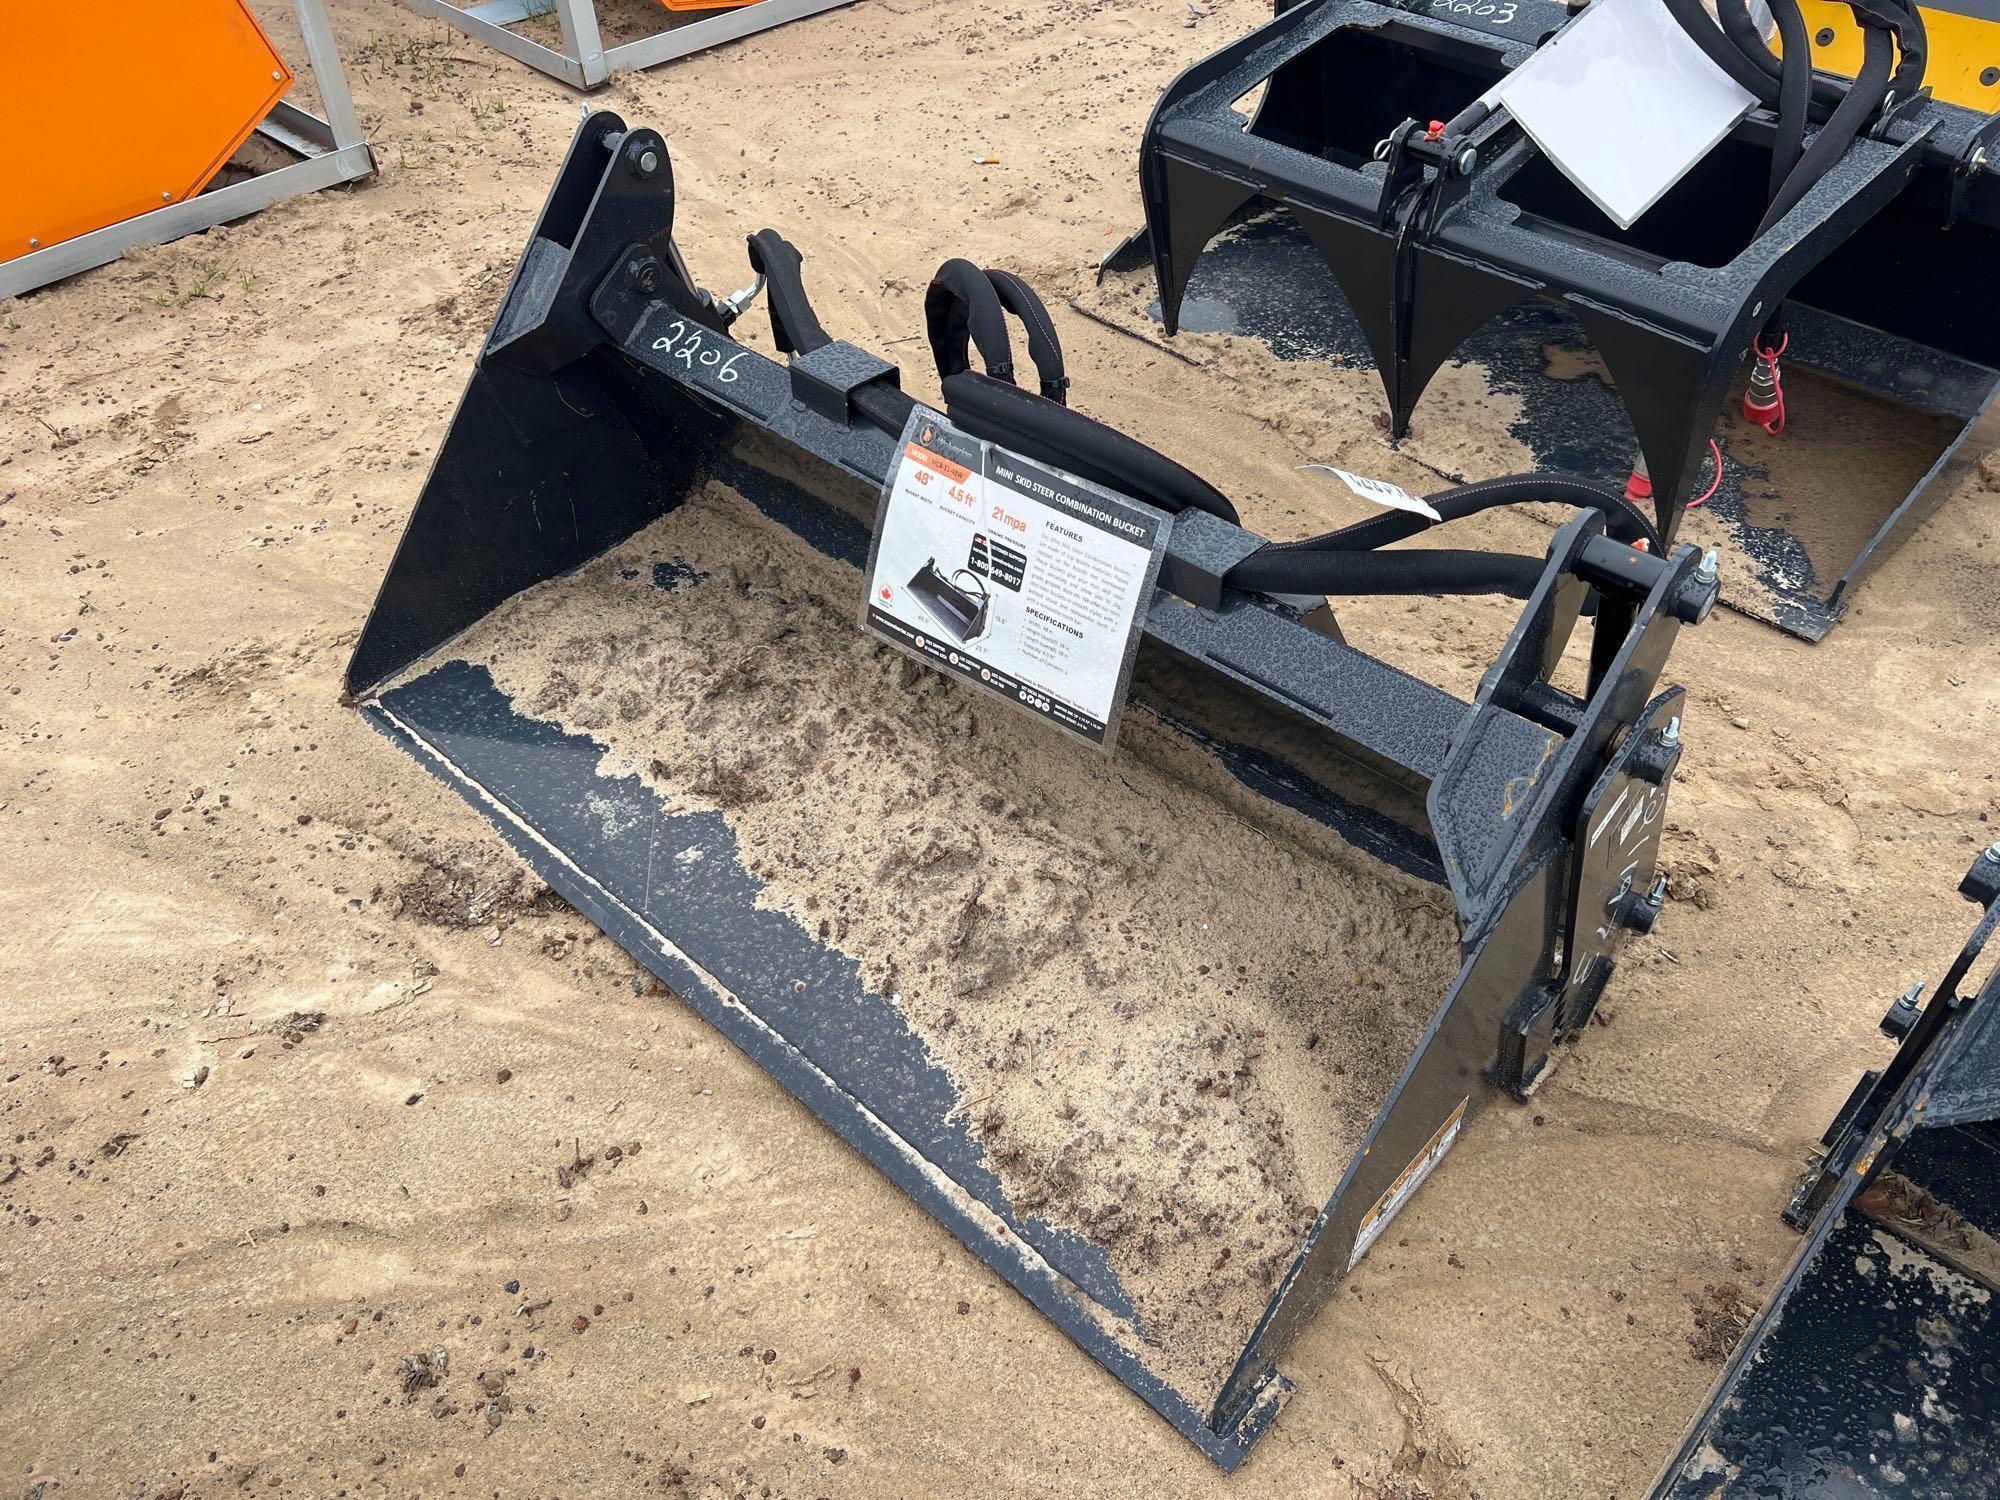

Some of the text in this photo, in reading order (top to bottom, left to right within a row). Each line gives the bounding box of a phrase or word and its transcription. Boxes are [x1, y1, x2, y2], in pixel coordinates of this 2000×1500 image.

[652, 321, 749, 382] 2206
[914, 469, 934, 487] 48"
[905, 489, 920, 498] BUCKET
[948, 485, 964, 502] 4.5
[996, 465, 1146, 539] MINI SKID STEER COMBINATION BUCKET
[940, 505, 975, 525] BUCKET CAPACITY
[992, 506, 1027, 534] 21 mpa
[988, 528, 1026, 549] ORKING PRESSURE
[1046, 521, 1083, 543] FEATURES
[1008, 552, 1025, 564] SUPPORT
[970, 557, 1021, 586] 1-800649-8017
[1025, 606, 1084, 639] SPECIFICATIONS
